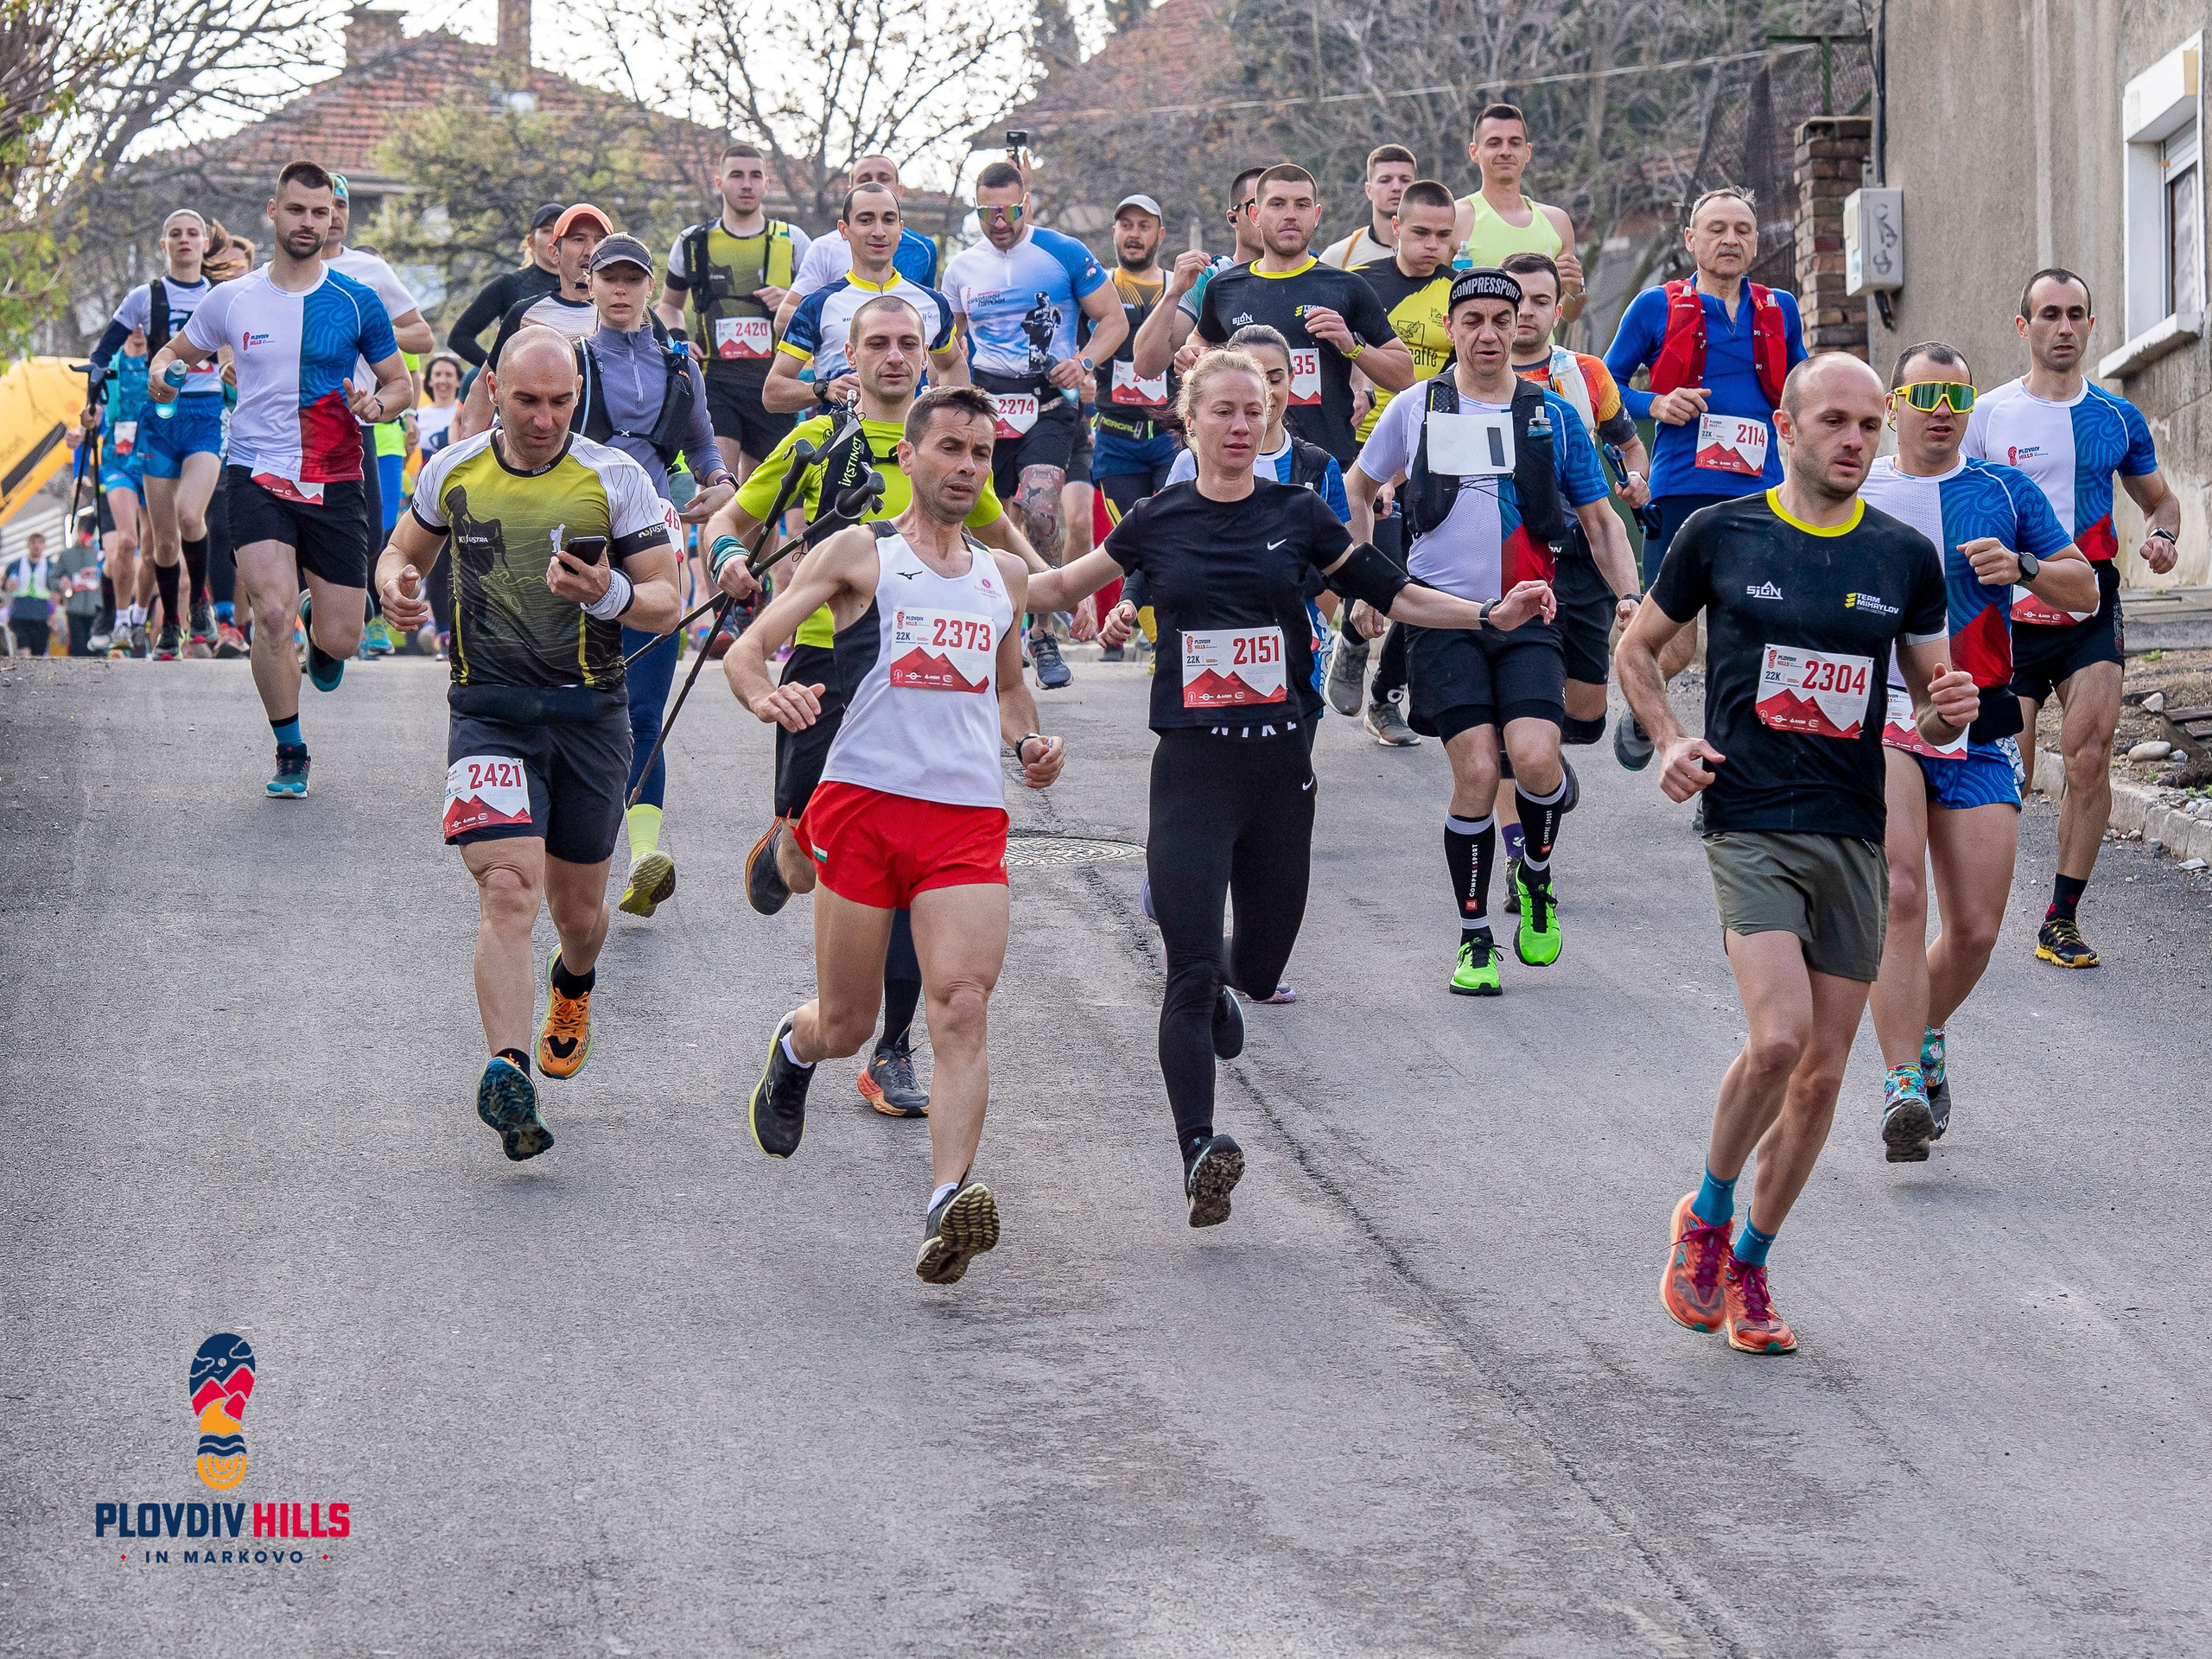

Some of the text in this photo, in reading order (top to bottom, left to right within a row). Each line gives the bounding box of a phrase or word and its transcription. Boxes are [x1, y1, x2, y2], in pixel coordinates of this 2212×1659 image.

[1452, 276, 1521, 300] COMPRESSPORT
[735, 322, 767, 336] 2420
[998, 398, 1034, 414] 2274
[1736, 423, 1765, 448] 2114
[1857, 593, 1881, 603] TEAM
[1857, 600, 1899, 614] MIHAYLOV
[896, 632, 911, 640] 22K
[932, 618, 991, 652] 2373
[1233, 634, 1280, 664] 2151
[1186, 655, 1200, 664] 22K
[1764, 671, 1781, 681] 22K
[1802, 660, 1866, 695] 2304
[467, 763, 522, 790] 2421
[1469, 843, 1478, 898] COMPRESSPORT
